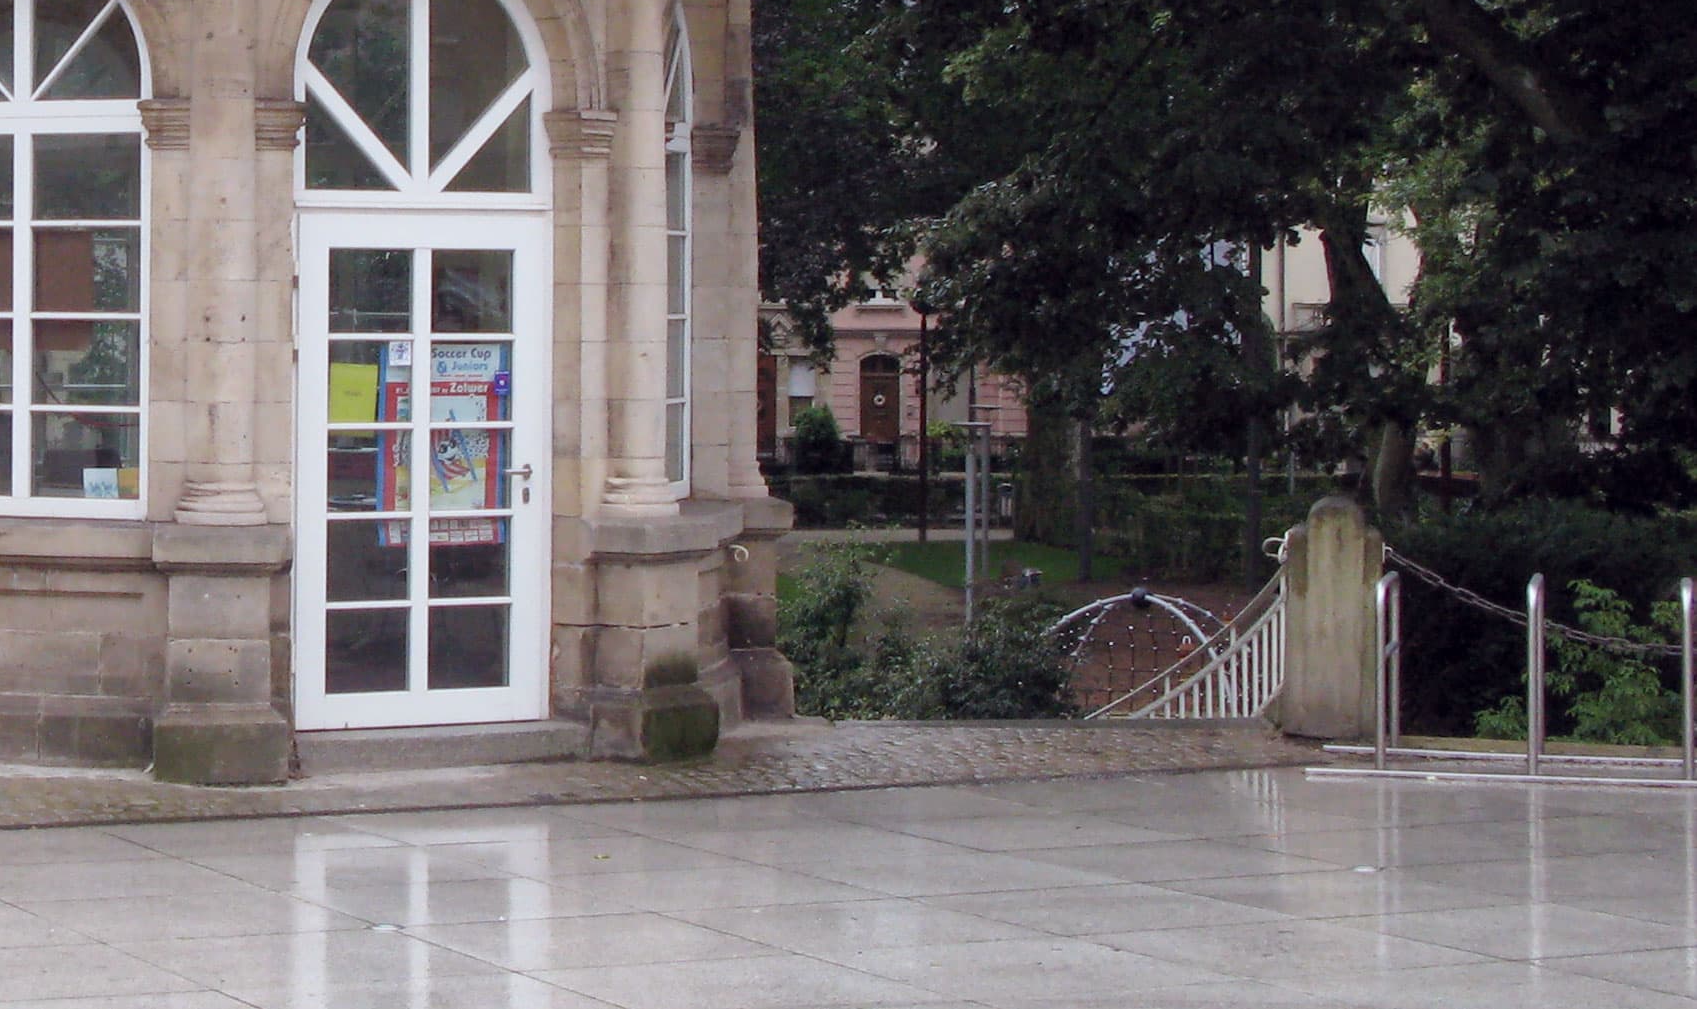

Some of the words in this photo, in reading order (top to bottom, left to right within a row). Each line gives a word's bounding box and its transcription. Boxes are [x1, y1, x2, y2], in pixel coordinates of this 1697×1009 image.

[431, 348, 466, 359] Soccer
[470, 348, 491, 360] Cup
[452, 361, 488, 371] Juniors
